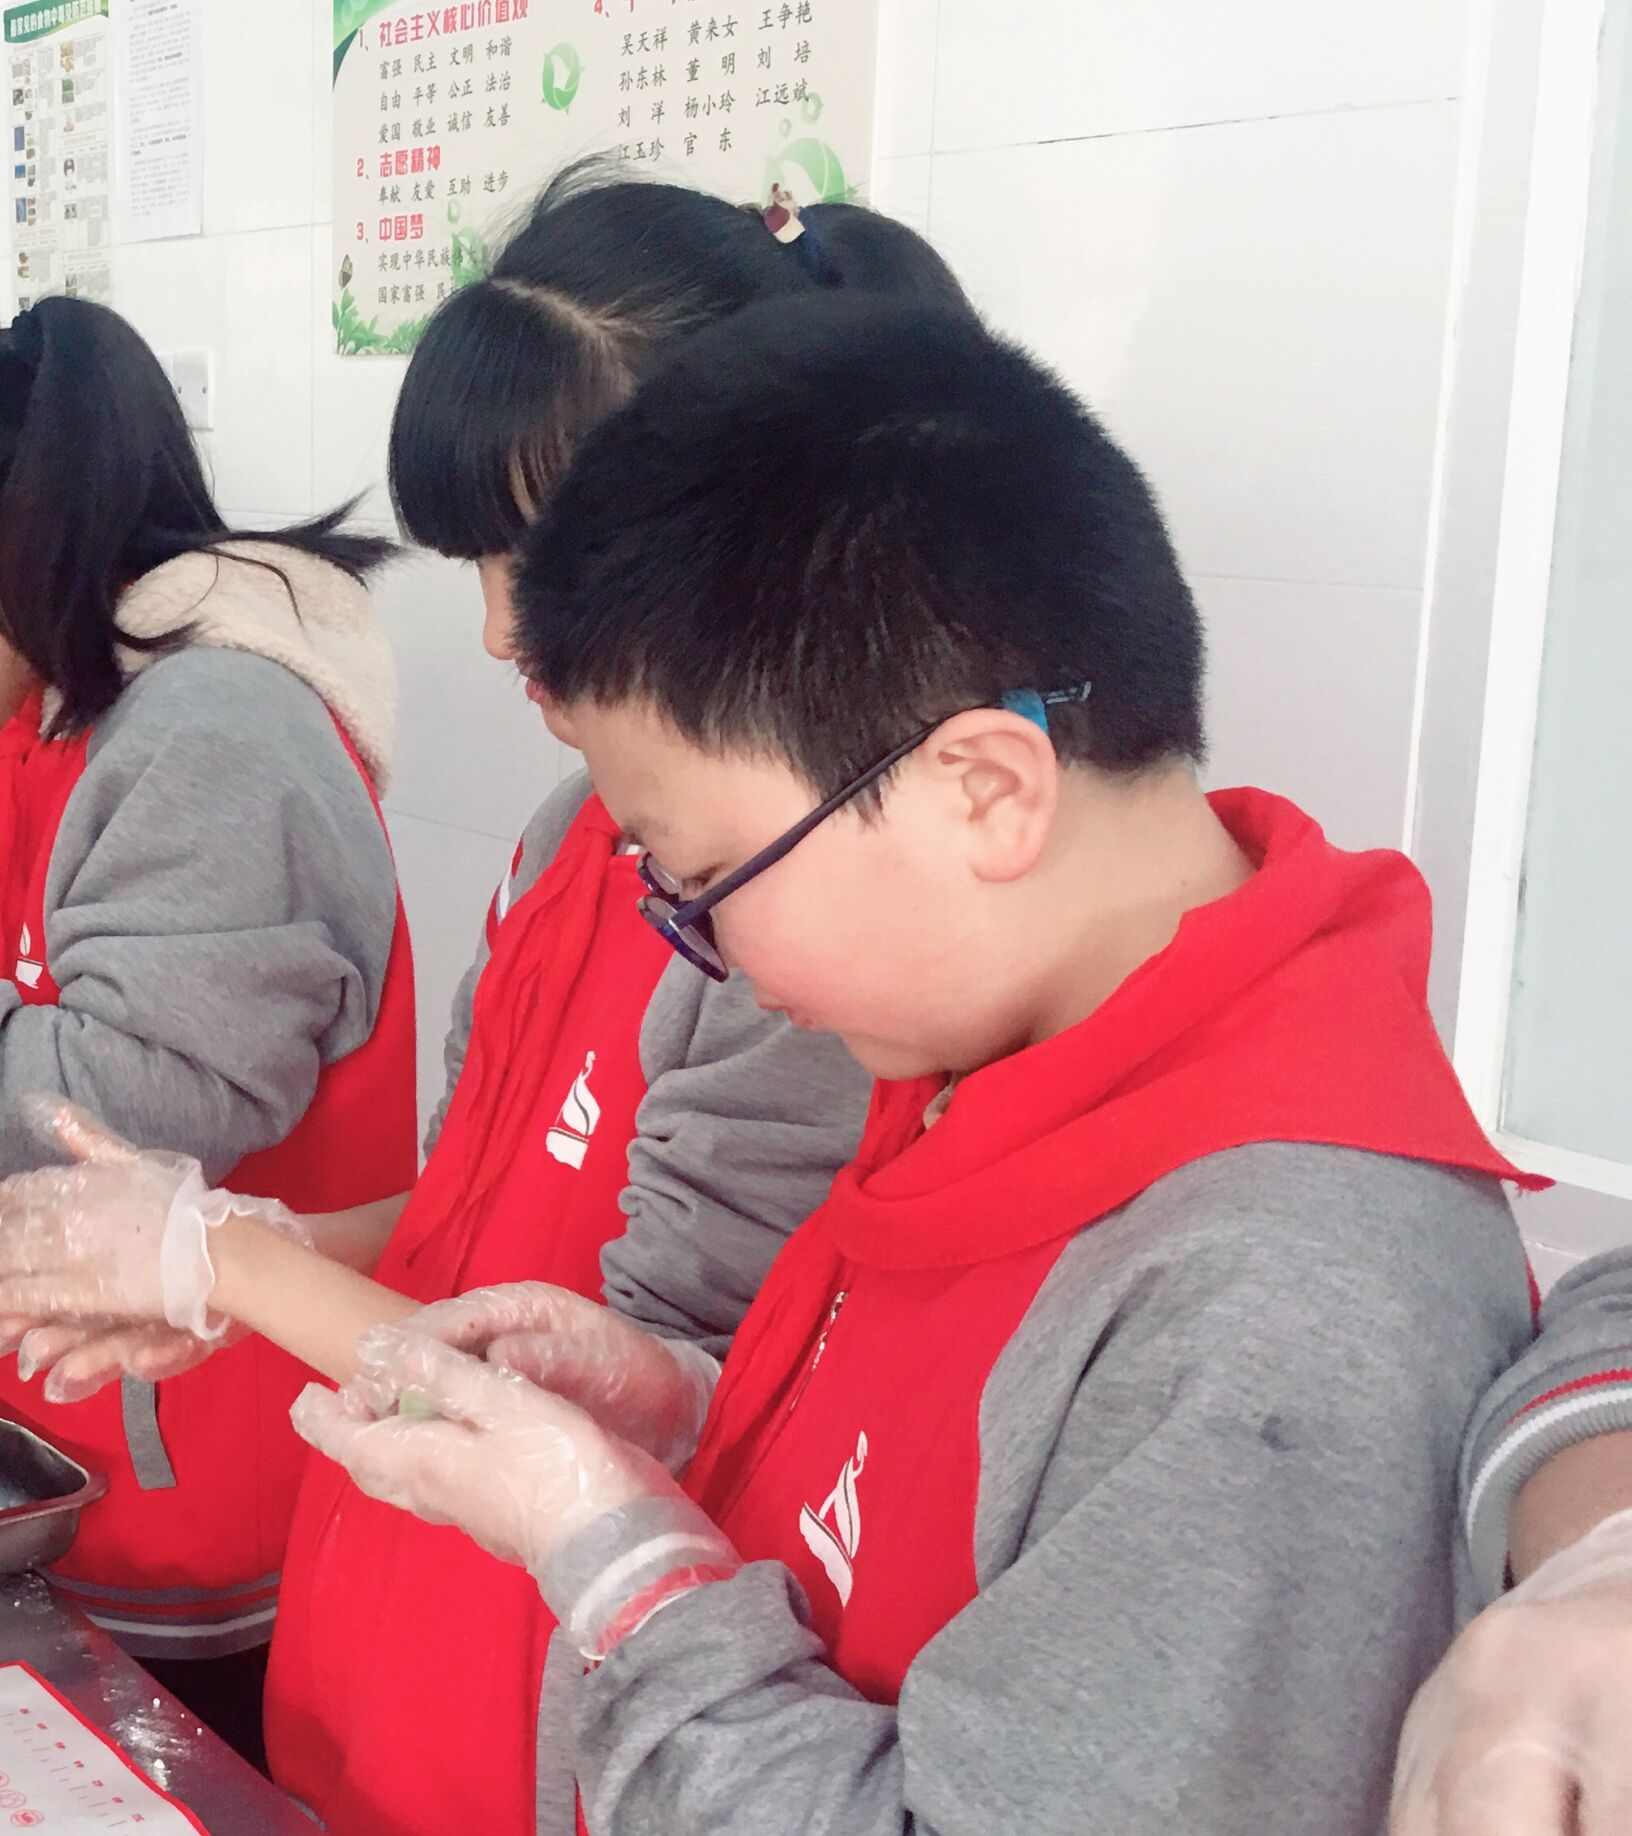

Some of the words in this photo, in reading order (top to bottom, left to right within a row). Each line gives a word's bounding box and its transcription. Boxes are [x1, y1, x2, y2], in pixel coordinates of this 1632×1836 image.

[621, 26, 668, 56] 吴天祥
[686, 14, 738, 46] 黄来女
[758, 1, 813, 31] 王争艳
[379, 58, 402, 80] 富强
[413, 51, 438, 73] 民主
[449, 43, 474, 66] 文明
[485, 35, 512, 60] 和谐
[619, 63, 667, 92] 孙东林
[380, 89, 402, 112] 自由
[412, 83, 437, 107] 平等
[448, 78, 473, 99] 公正
[485, 70, 512, 93] 法治
[684, 89, 736, 119] 杨小玲
[755, 77, 810, 108] 江远斌
[378, 122, 401, 143] 爱国
[412, 117, 436, 138] 敬业
[447, 110, 472, 133] 诚信
[484, 102, 511, 128] 友善
[378, 185, 401, 205] 奉献
[411, 179, 435, 202] 友爱
[447, 175, 472, 196] 互助
[483, 170, 509, 193] 进步
[378, 284, 425, 304] 国家富强
